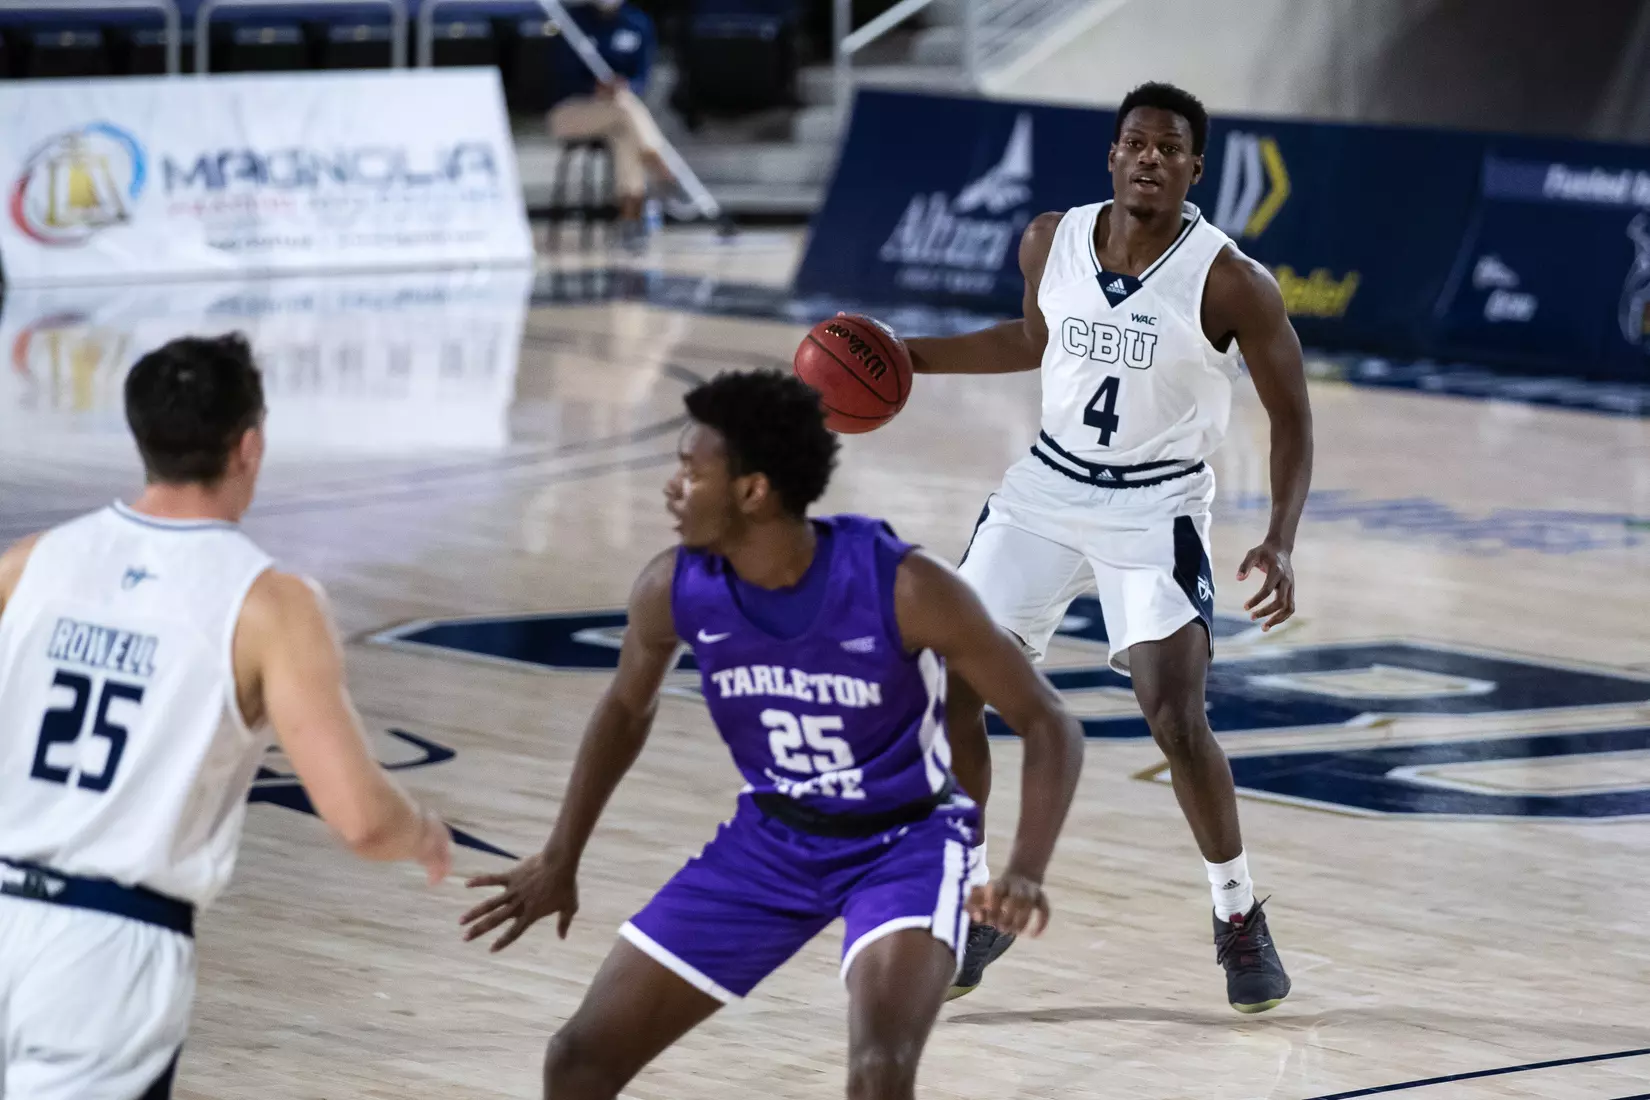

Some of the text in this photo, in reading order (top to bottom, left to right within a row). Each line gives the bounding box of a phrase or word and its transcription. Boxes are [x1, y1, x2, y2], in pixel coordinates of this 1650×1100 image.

[1061, 316, 1158, 370] CBU
[1131, 313, 1157, 326] WAC
[1083, 376, 1120, 447] 4
[47, 617, 159, 677] ROWELL
[711, 665, 882, 708] TARLETON
[30, 668, 145, 794] 25
[760, 708, 855, 774] 25
